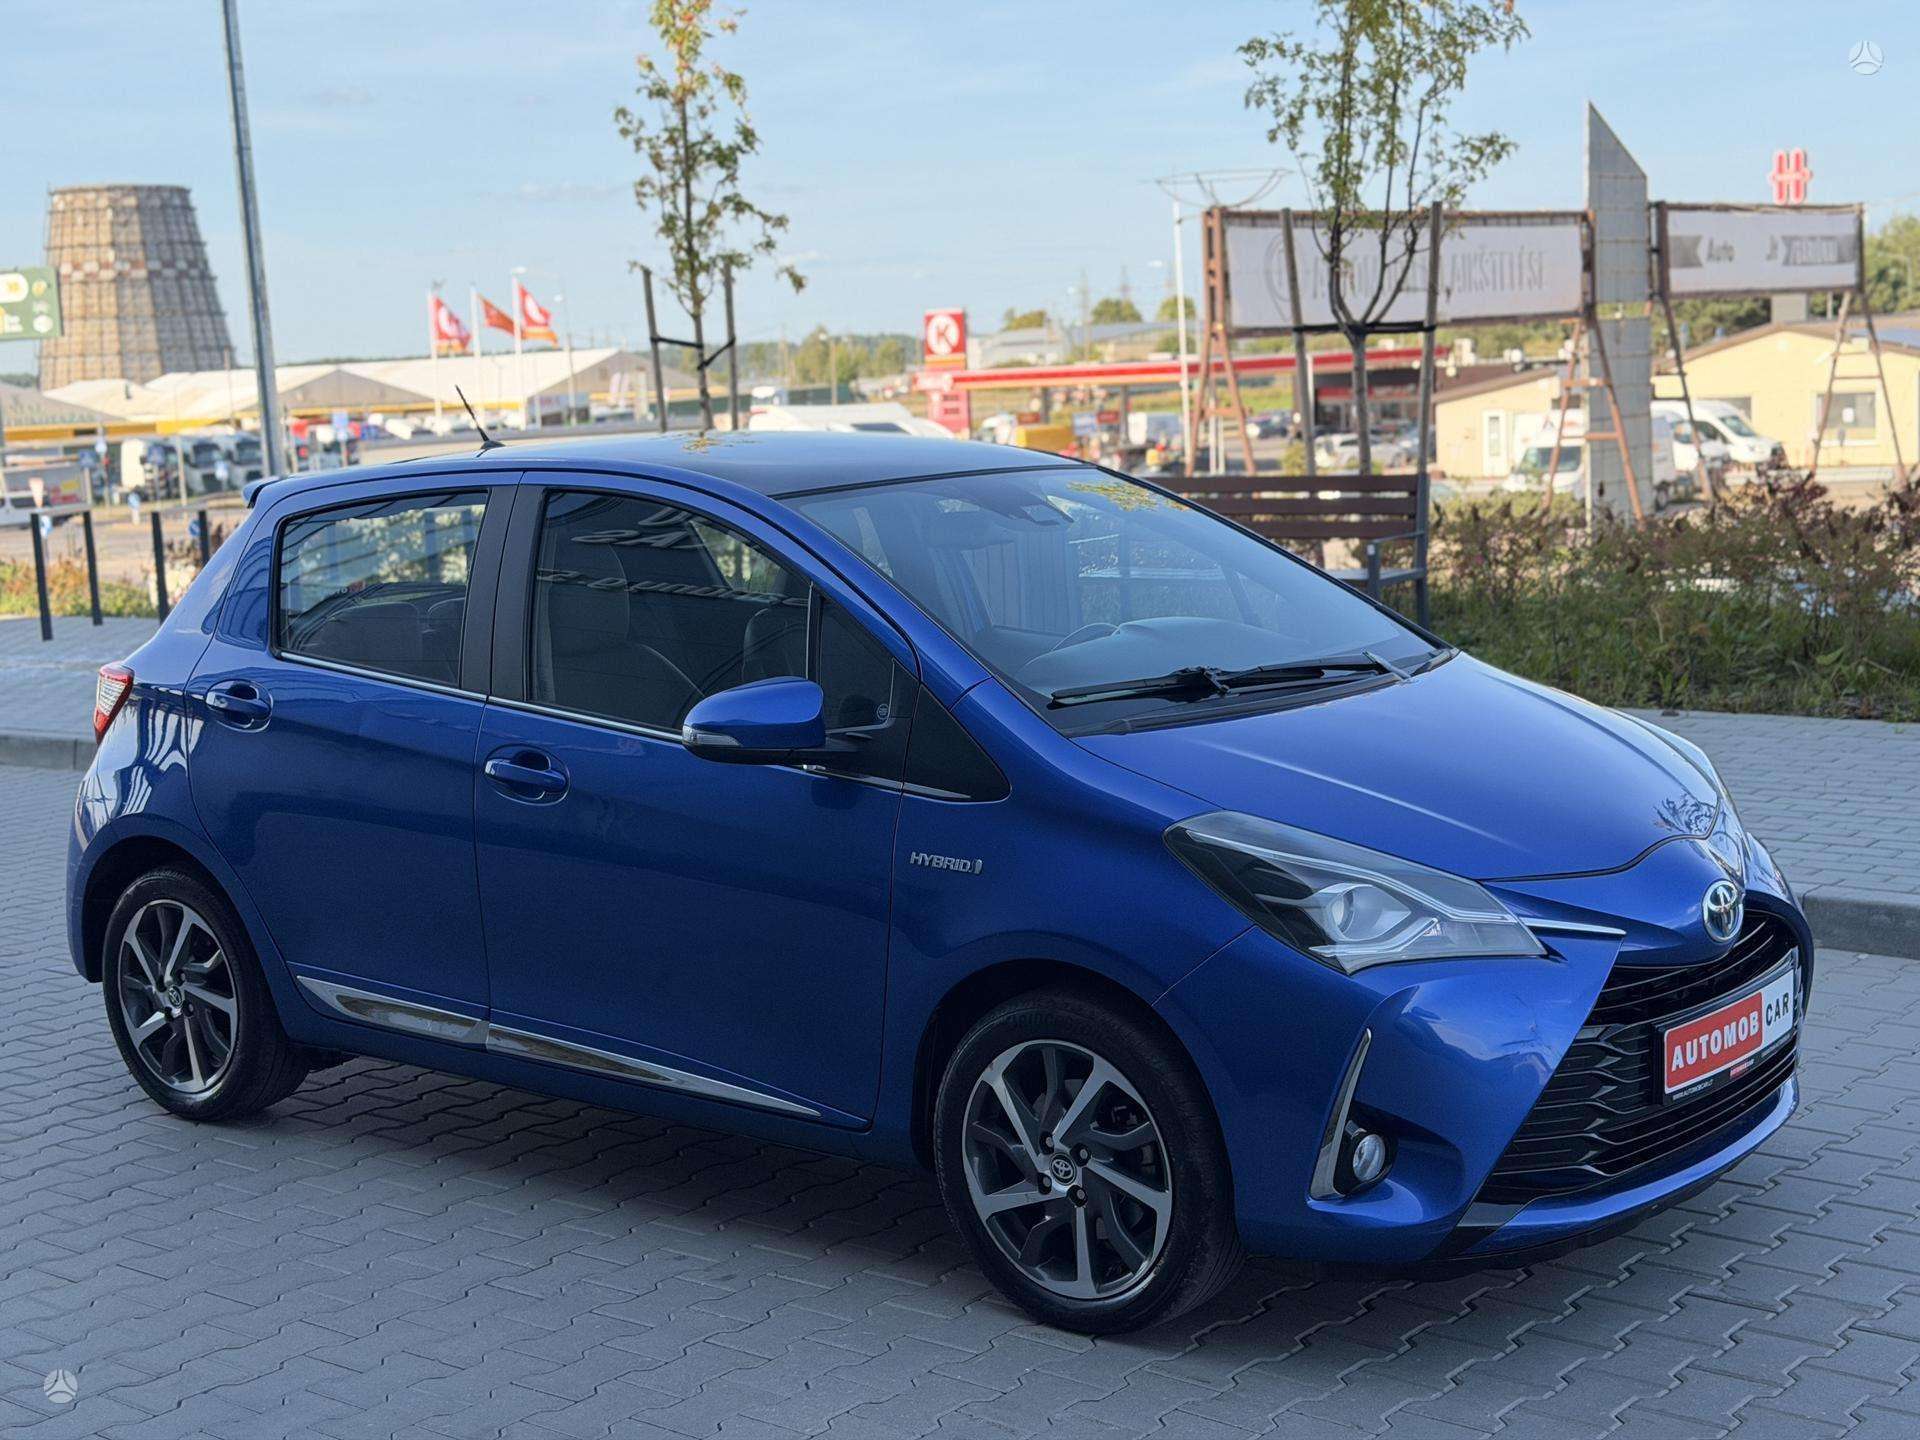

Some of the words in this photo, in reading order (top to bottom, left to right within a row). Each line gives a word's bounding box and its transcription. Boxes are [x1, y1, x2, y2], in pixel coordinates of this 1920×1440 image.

[909, 851, 971, 873] HYBRID
[1671, 1011, 1759, 1072] AUTOMOB
[1765, 992, 1790, 1026] CAR
